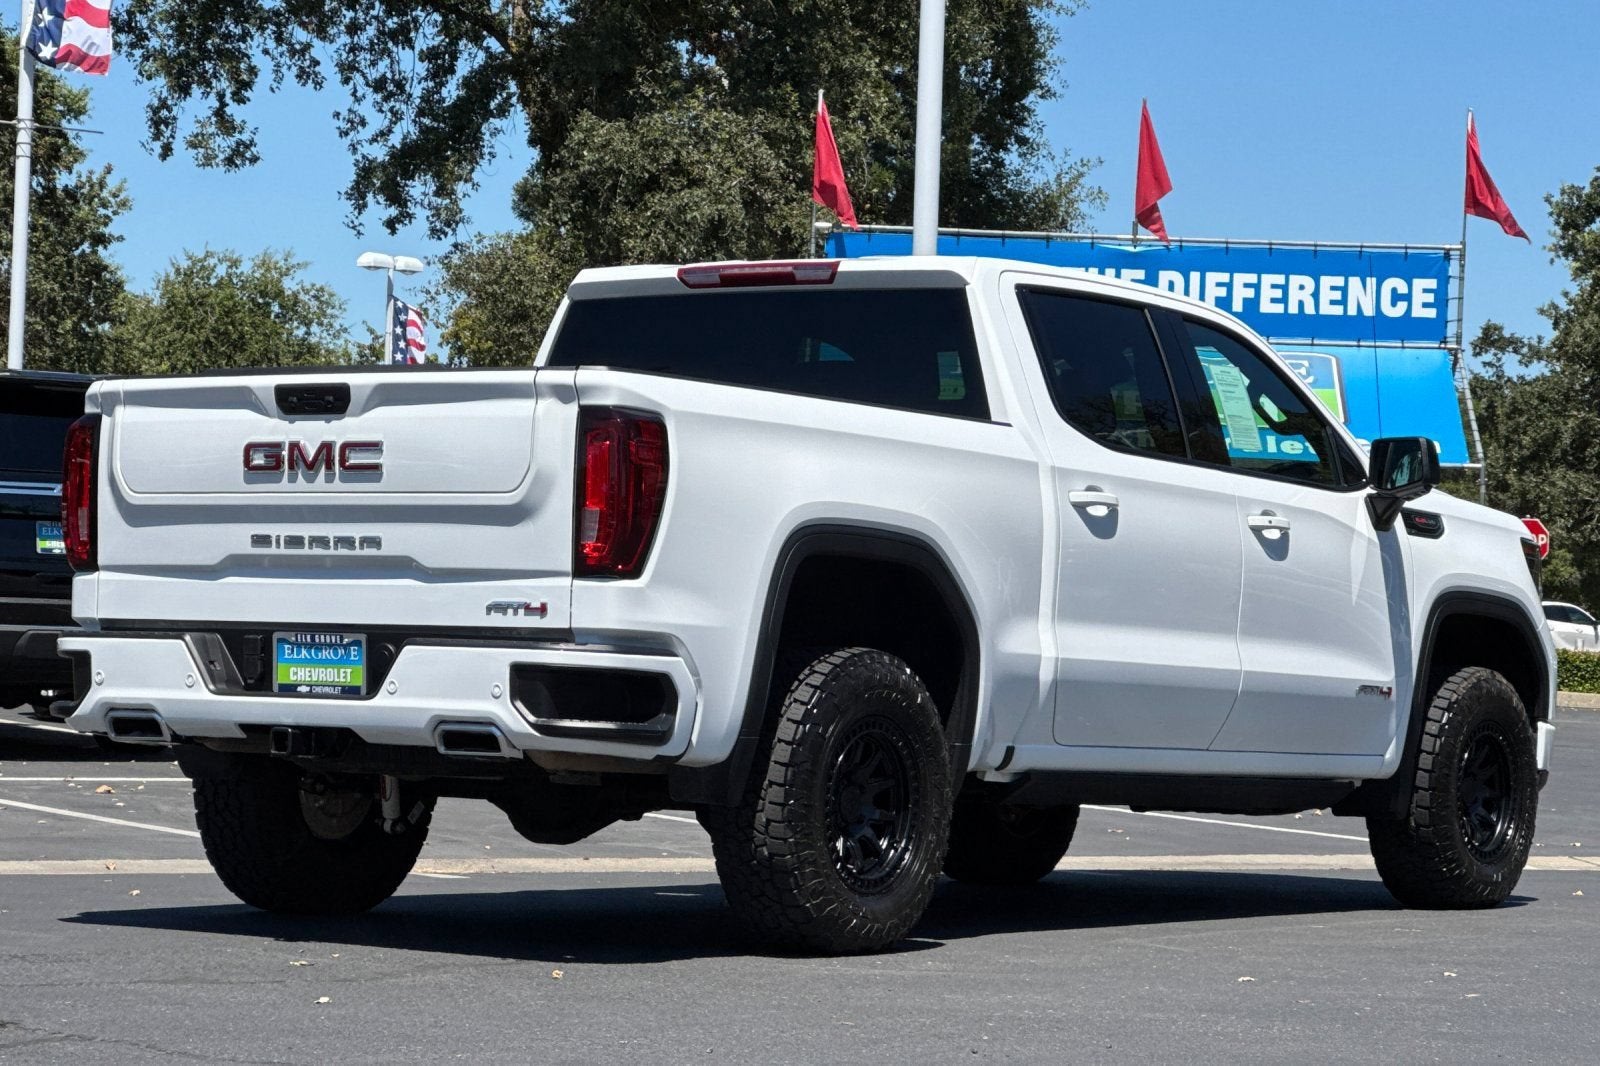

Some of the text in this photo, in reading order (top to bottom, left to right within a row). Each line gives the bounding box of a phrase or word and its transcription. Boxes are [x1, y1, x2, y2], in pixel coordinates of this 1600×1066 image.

[1158, 270, 1438, 318] DIFFERENCE
[243, 440, 383, 473] GMC
[251, 534, 382, 550] SIERRA
[486, 601, 548, 619] AT4
[297, 633, 340, 643] ELK GROVE
[283, 645, 359, 660] ELK GROVE
[289, 667, 352, 682] CHEVROLET
[312, 686, 341, 694] CHEVROLET
